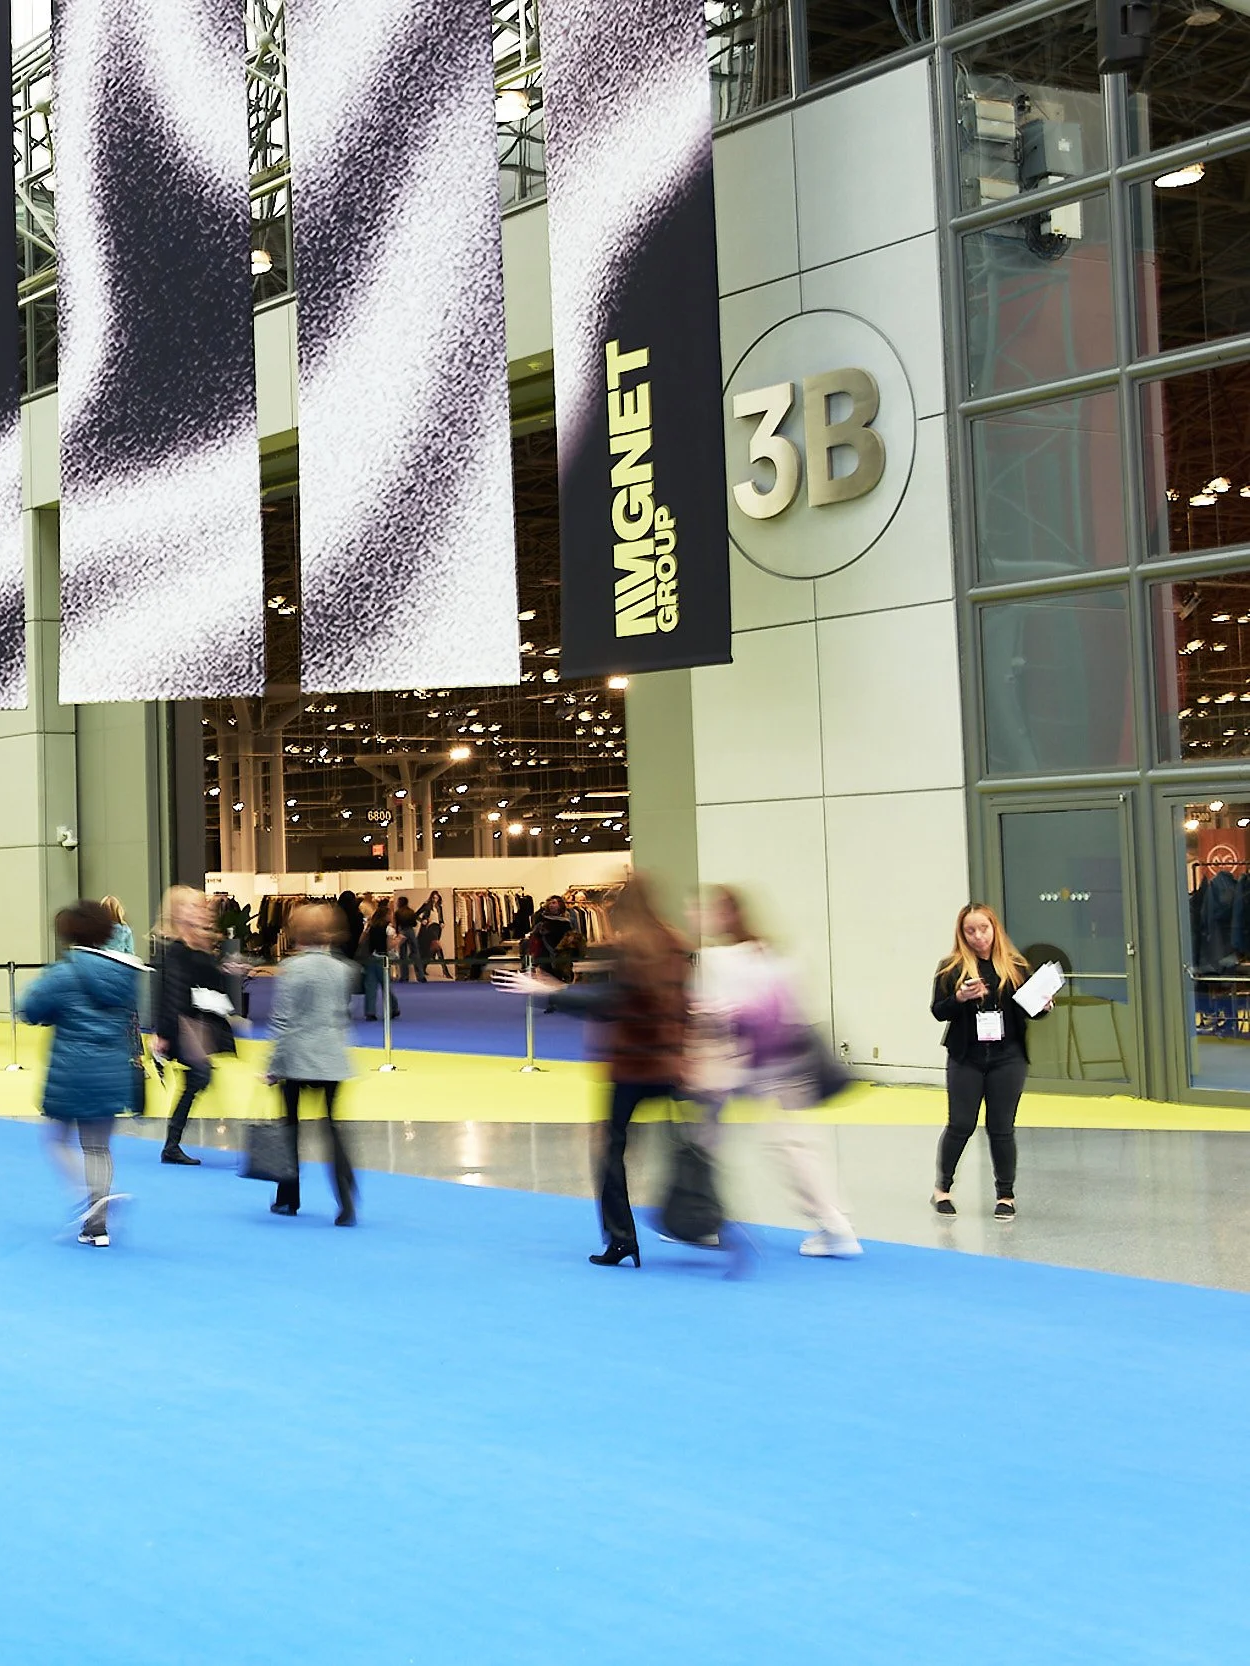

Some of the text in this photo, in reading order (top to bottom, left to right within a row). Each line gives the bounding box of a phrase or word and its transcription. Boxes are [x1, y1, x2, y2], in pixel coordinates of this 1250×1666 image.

[732, 367, 886, 520] 3B
[654, 505, 680, 633] GROUP
[367, 810, 391, 821] 6800
